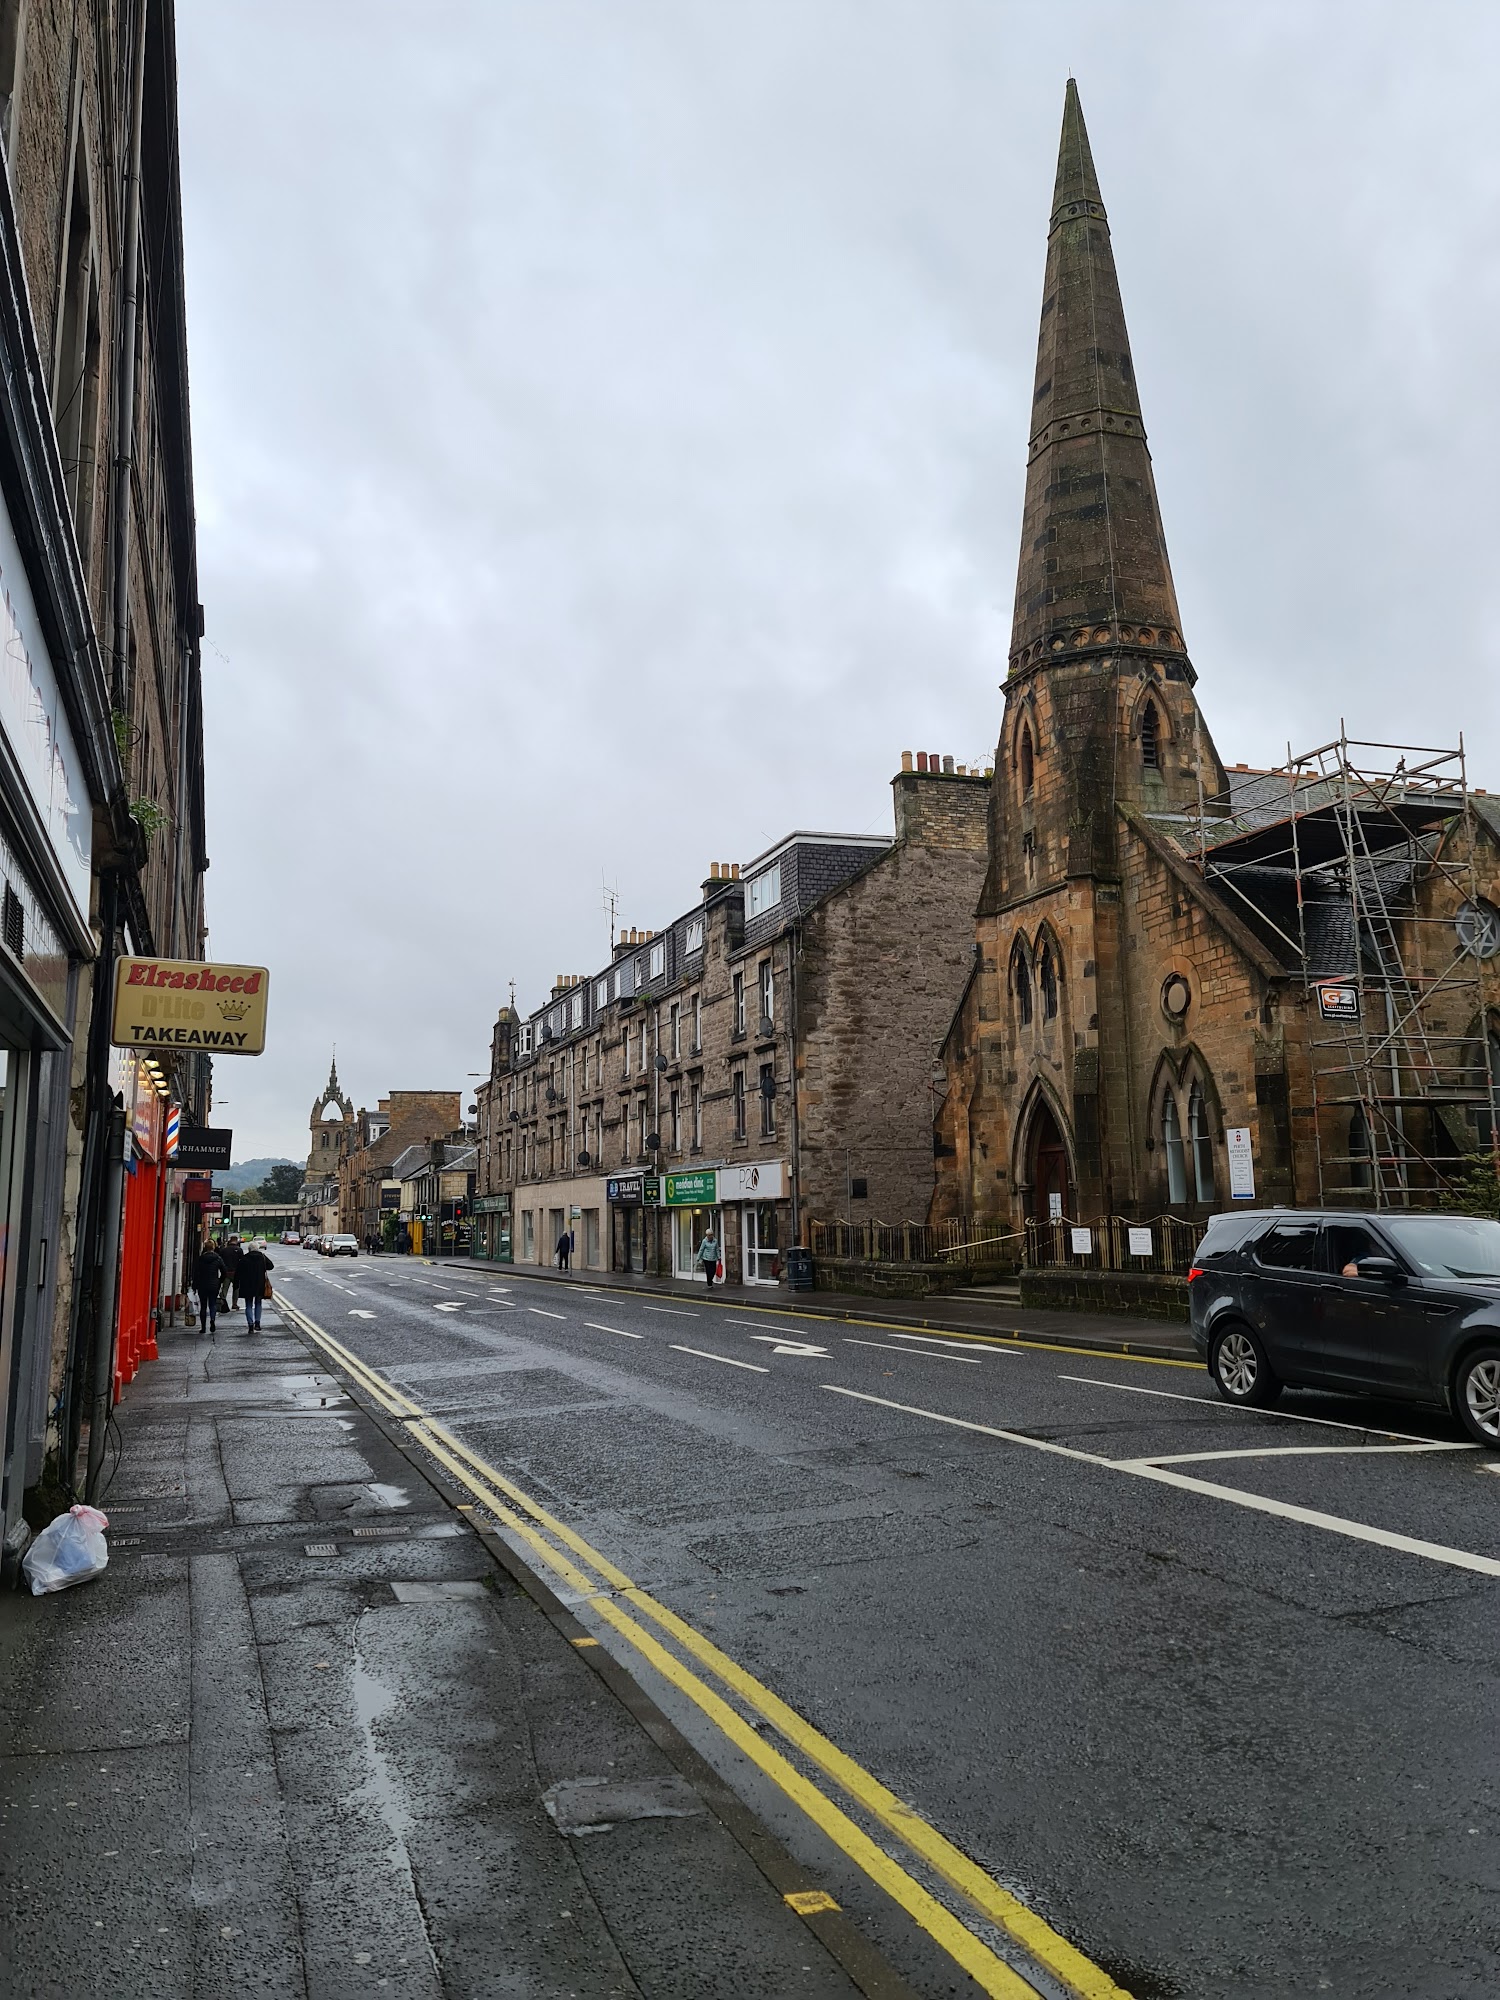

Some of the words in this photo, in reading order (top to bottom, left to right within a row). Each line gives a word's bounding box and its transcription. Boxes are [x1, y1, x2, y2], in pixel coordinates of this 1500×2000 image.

[125, 963, 262, 995] Elrasheed
[1324, 992, 1352, 1004] G2
[141, 994, 206, 1021] D'Lite
[130, 1025, 249, 1046] TAKEAWAY
[177, 1145, 227, 1154] ARHAMMER
[619, 1180, 641, 1192] TRAVEL
